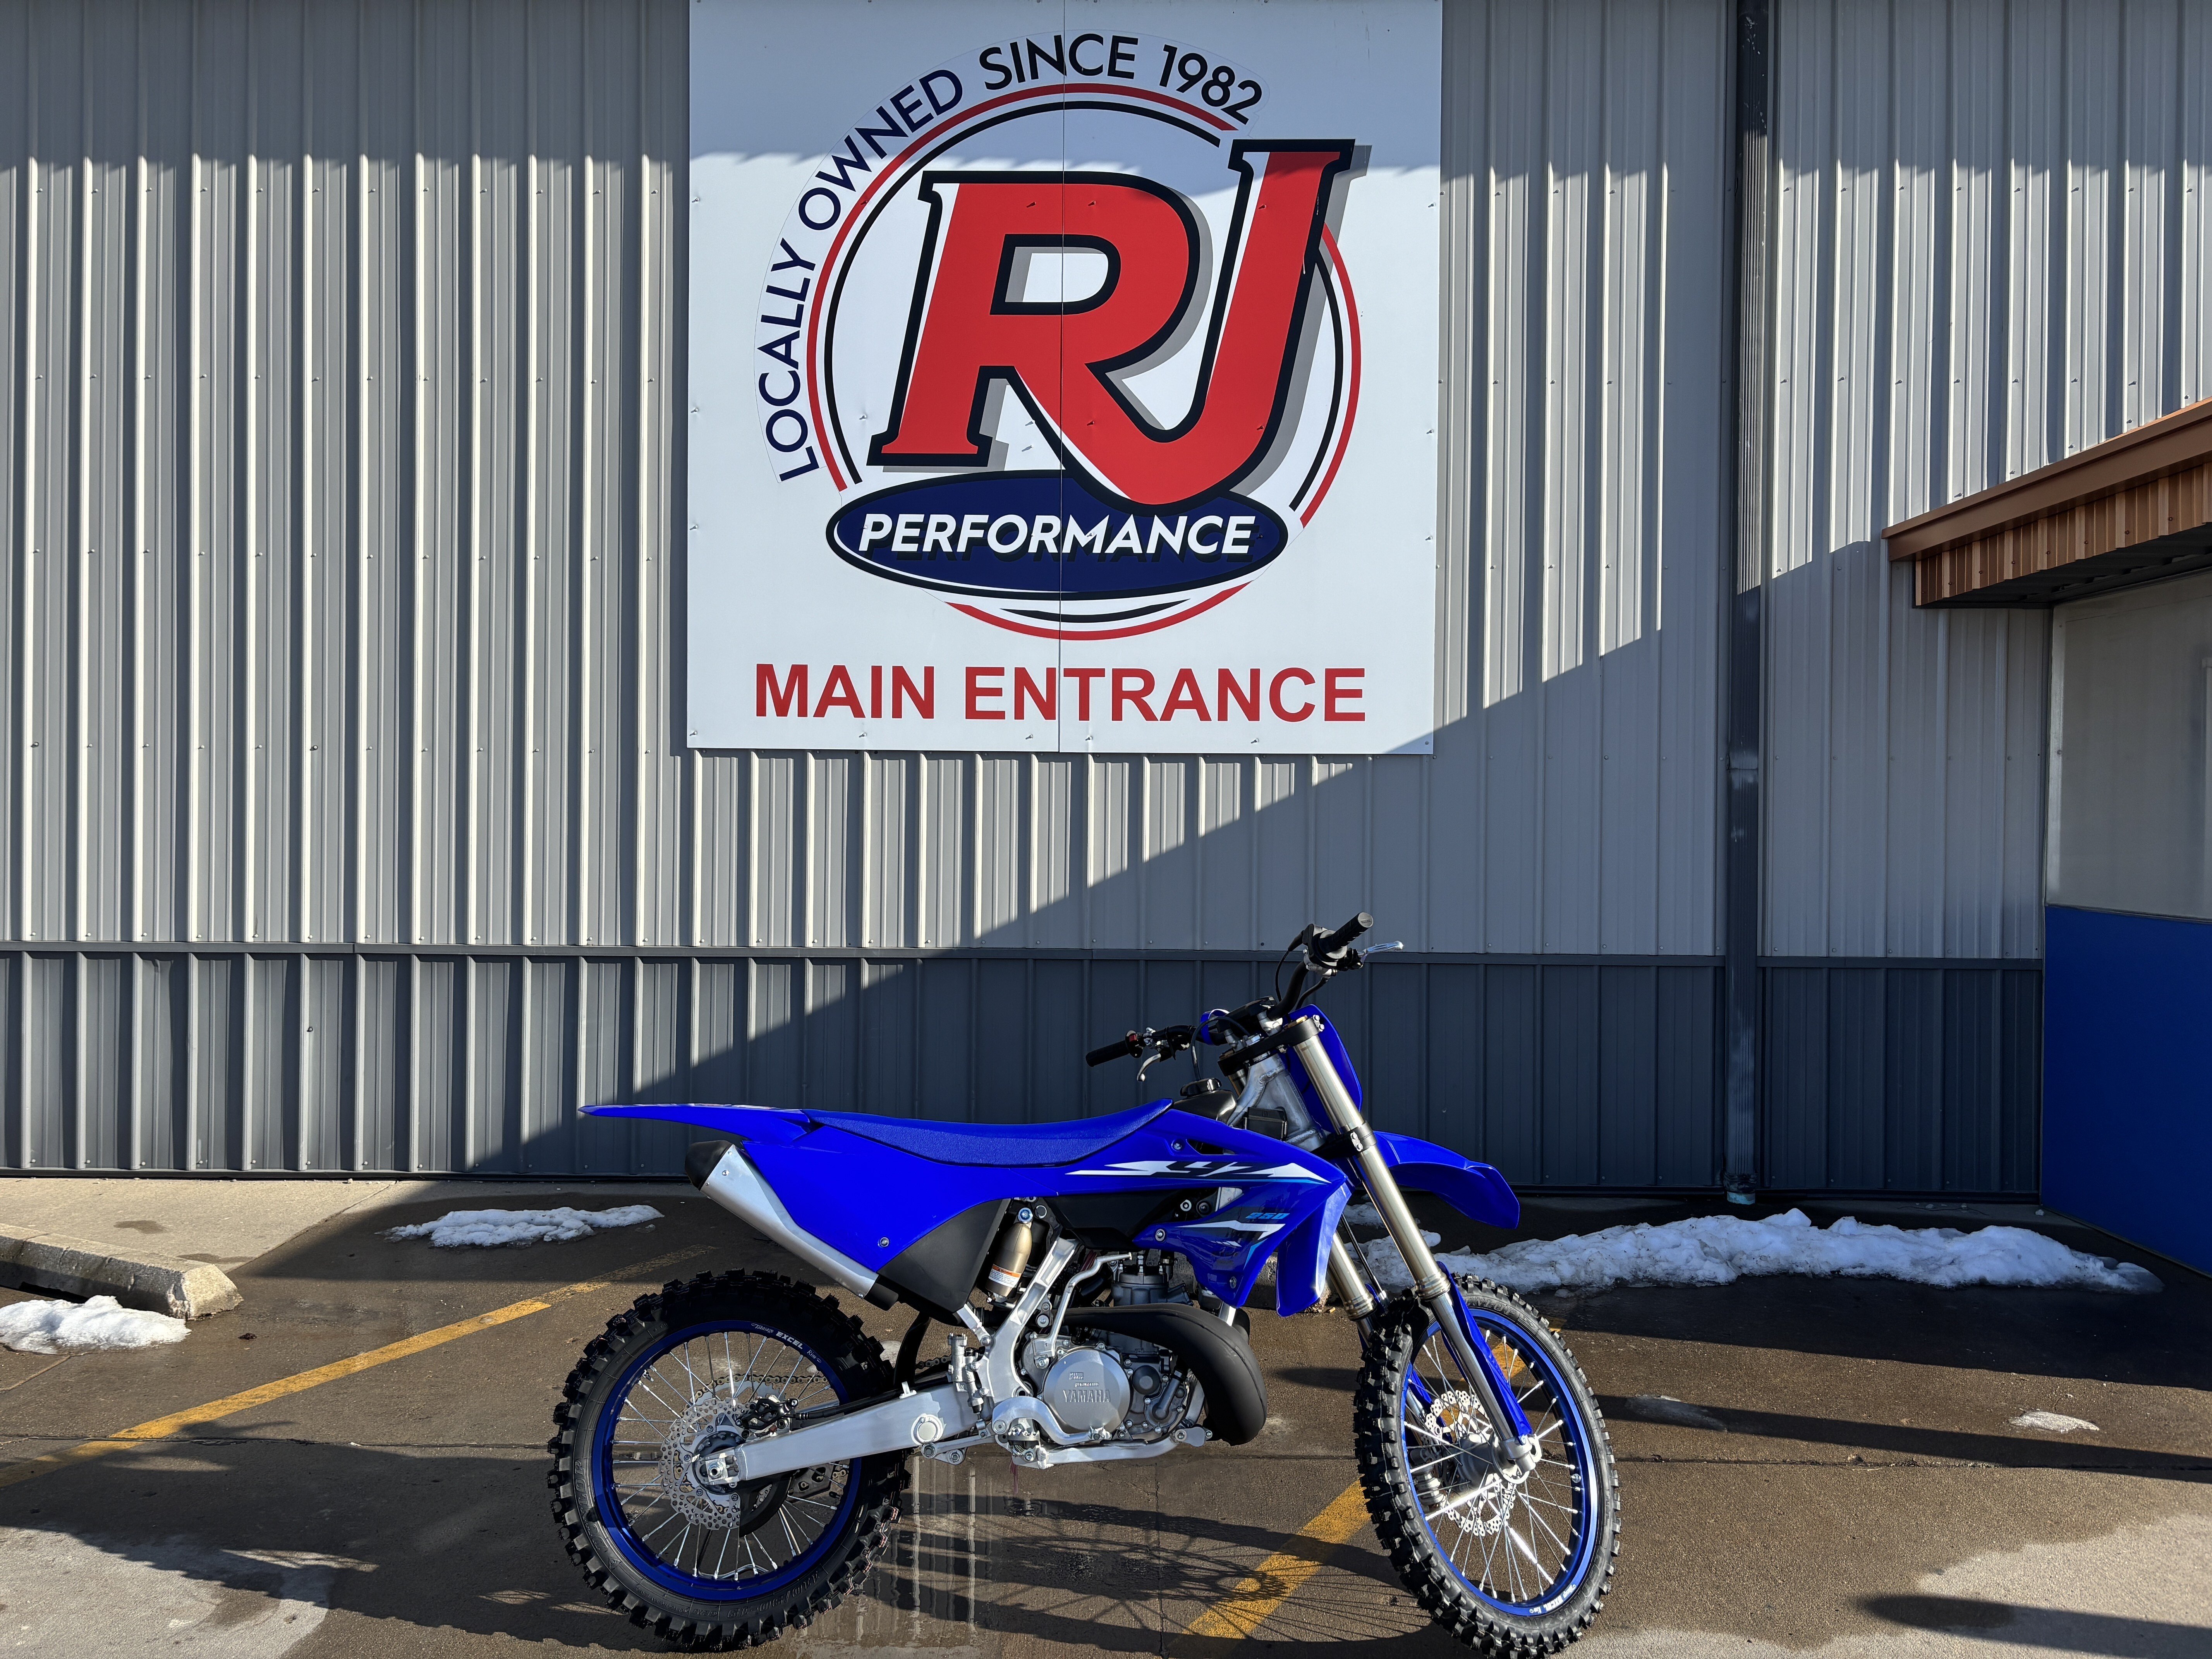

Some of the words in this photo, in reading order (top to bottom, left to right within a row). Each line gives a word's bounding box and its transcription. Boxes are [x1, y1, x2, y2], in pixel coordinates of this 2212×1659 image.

[758, 237, 817, 481] LOCALLY
[798, 68, 963, 231] OWNED
[979, 33, 1140, 91] SINCE
[1158, 44, 1263, 125] 1982
[867, 139, 1355, 514] RJ
[859, 513, 1258, 555] PERFORMANCE
[756, 663, 934, 718] MAIN
[965, 666, 1367, 723] ENTRANCE
[776, 1331, 803, 1350] EXCEL
[1063, 1389, 1111, 1403] YAMAHA
